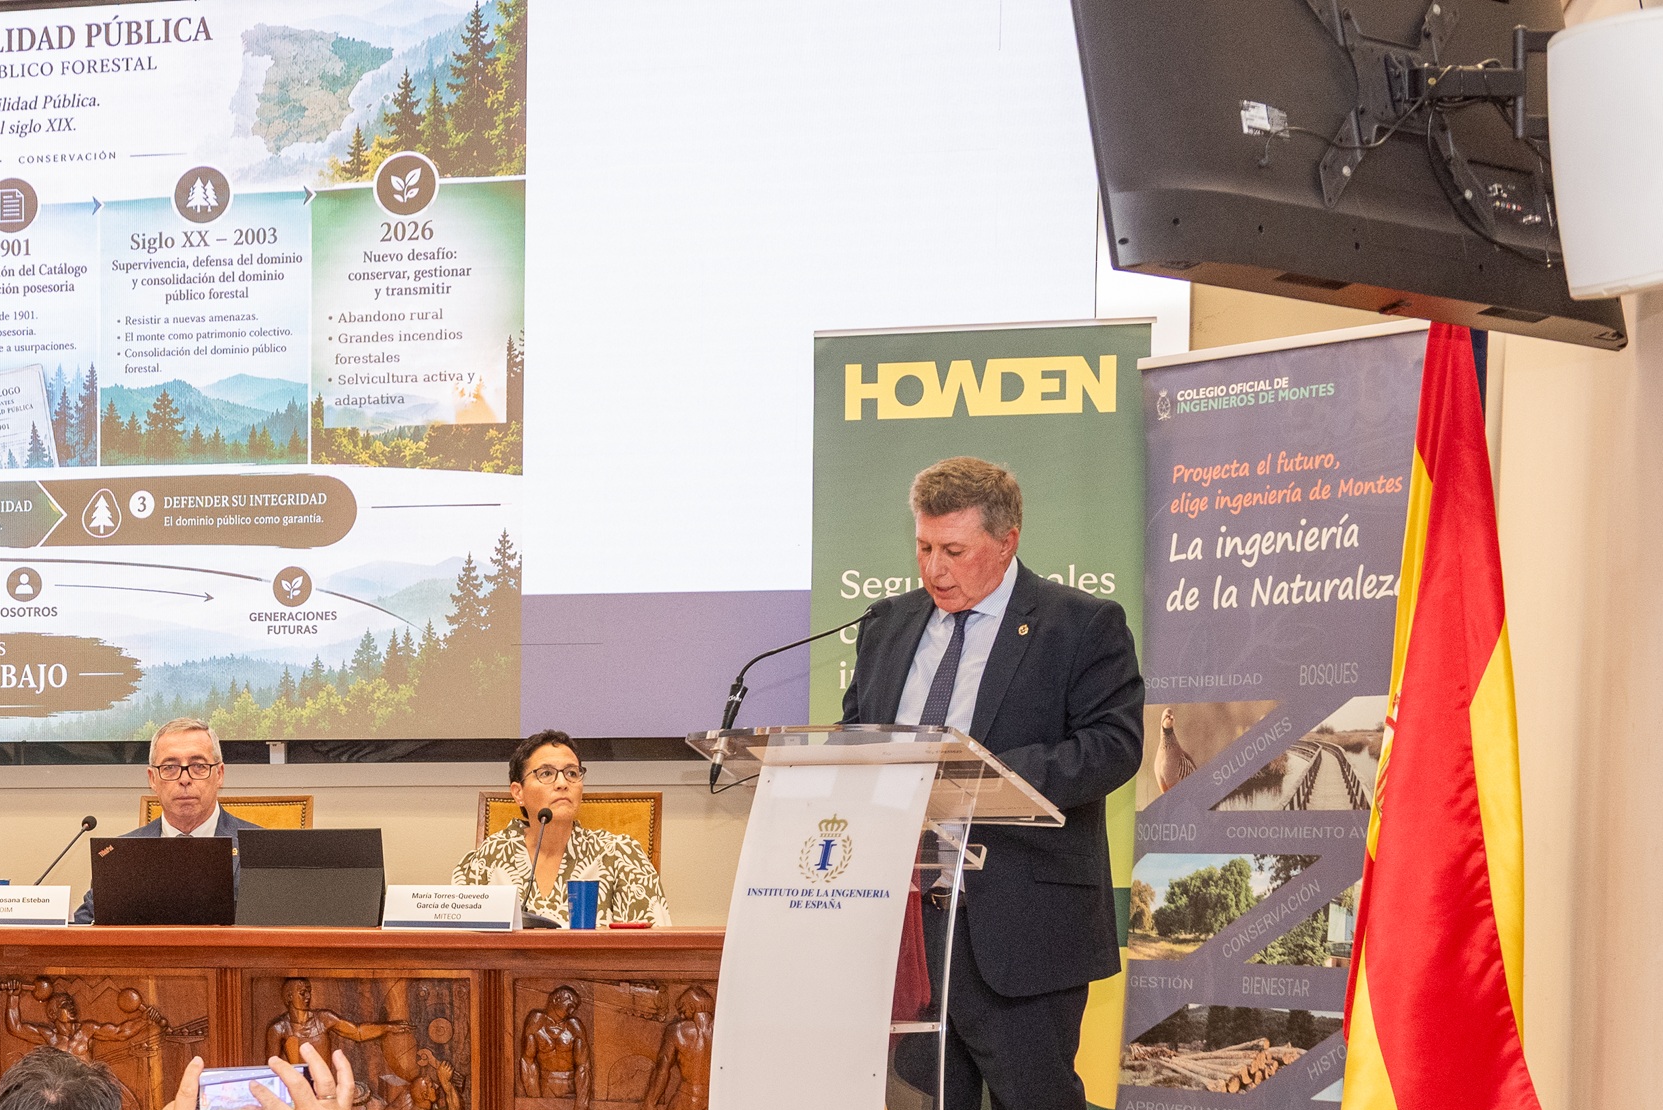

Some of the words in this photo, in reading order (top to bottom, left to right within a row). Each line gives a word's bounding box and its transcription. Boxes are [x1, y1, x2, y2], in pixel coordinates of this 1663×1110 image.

[85, 16, 213, 48] PÚBLICA
[61, 55, 157, 75] FORESTAL
[18, 150, 115, 164] CONSERVACIÓN
[130, 231, 175, 254] Siglo
[181, 230, 209, 247] XX
[233, 226, 277, 245] 2003
[379, 219, 433, 242] 2026
[363, 250, 403, 262] Nuevo
[407, 246, 456, 261] desafío:
[18, 264, 35, 276] del
[38, 262, 87, 277] Catálogo
[13, 310, 37, 320] 1901.
[125, 314, 161, 325] Resistir
[163, 316, 169, 324] a
[172, 315, 205, 323] nuevas
[208, 313, 258, 322] amenazas.
[337, 310, 405, 323] Abandono
[409, 307, 442, 320] rural
[337, 331, 394, 343] Grandes
[398, 328, 462, 341] incendios
[844, 354, 1117, 421] HOWDEN
[1176, 385, 1226, 400] COLEGIO
[1228, 379, 1271, 394] OFICIAL
[1273, 376, 1288, 389] DE
[1176, 392, 1255, 414] INGENIEROS
[1258, 390, 1274, 404] DE
[1278, 383, 1334, 401] MONTES
[1172, 459, 1249, 487] Proyecta
[1256, 454, 1271, 475] el
[1276, 451, 1339, 473] futuro,
[163, 495, 229, 508] DEFENDER
[231, 494, 246, 507] SU
[249, 492, 326, 506] INTEGRIDAD
[1170, 491, 1208, 517] elige
[1214, 484, 1301, 513] ingeniería
[1308, 479, 1331, 500] de
[1337, 474, 1402, 498] Montes
[1169, 532, 1202, 562] La
[1216, 514, 1359, 568] ingeniería
[840, 569, 923, 599] Segu
[1165, 577, 1199, 611] de
[1212, 574, 1238, 609] la
[1144, 672, 1263, 690] SOSTENIBILIDAD
[1299, 661, 1358, 686] BOSQUES
[1212, 717, 1292, 786] SOLUCIONES
[1137, 823, 1197, 841] SOCIEDAD
[1225, 824, 1344, 838] CONOCIMIENTO
[747, 887, 799, 897] INSTITUTO
[801, 888, 814, 897] DE
[816, 888, 829, 898] LA
[831, 888, 890, 898] INGENIERIA
[789, 900, 803, 909] DE
[805, 898, 842, 909] ESPAÑA
[1222, 879, 1321, 958] CONSERVACIÓN
[1129, 974, 1193, 990] GESTIÓN
[1241, 975, 1309, 996] BIENESTAR
[1307, 1044, 1347, 1081] HISTO
